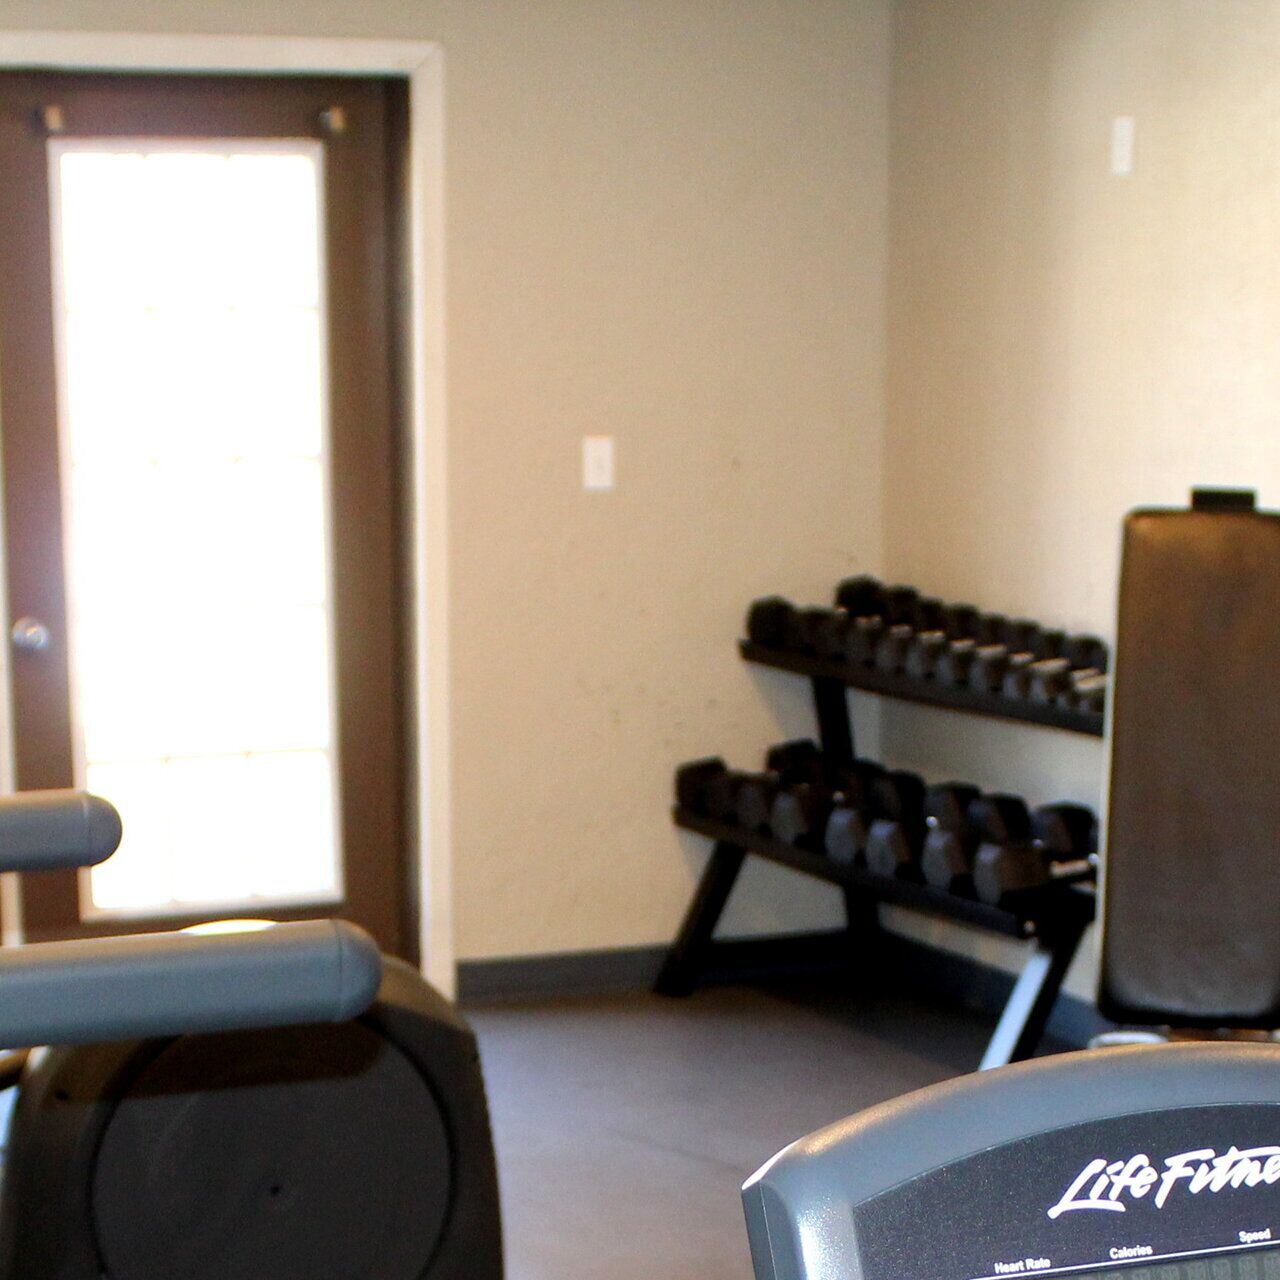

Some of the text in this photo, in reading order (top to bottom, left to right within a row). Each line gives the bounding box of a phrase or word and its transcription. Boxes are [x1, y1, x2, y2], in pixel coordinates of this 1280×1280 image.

[1047, 1153, 1158, 1219] Life
[1238, 1228, 1271, 1243] Speed
[1109, 1244, 1153, 1259] Calories
[994, 1257, 1051, 1274] Heart Rate
